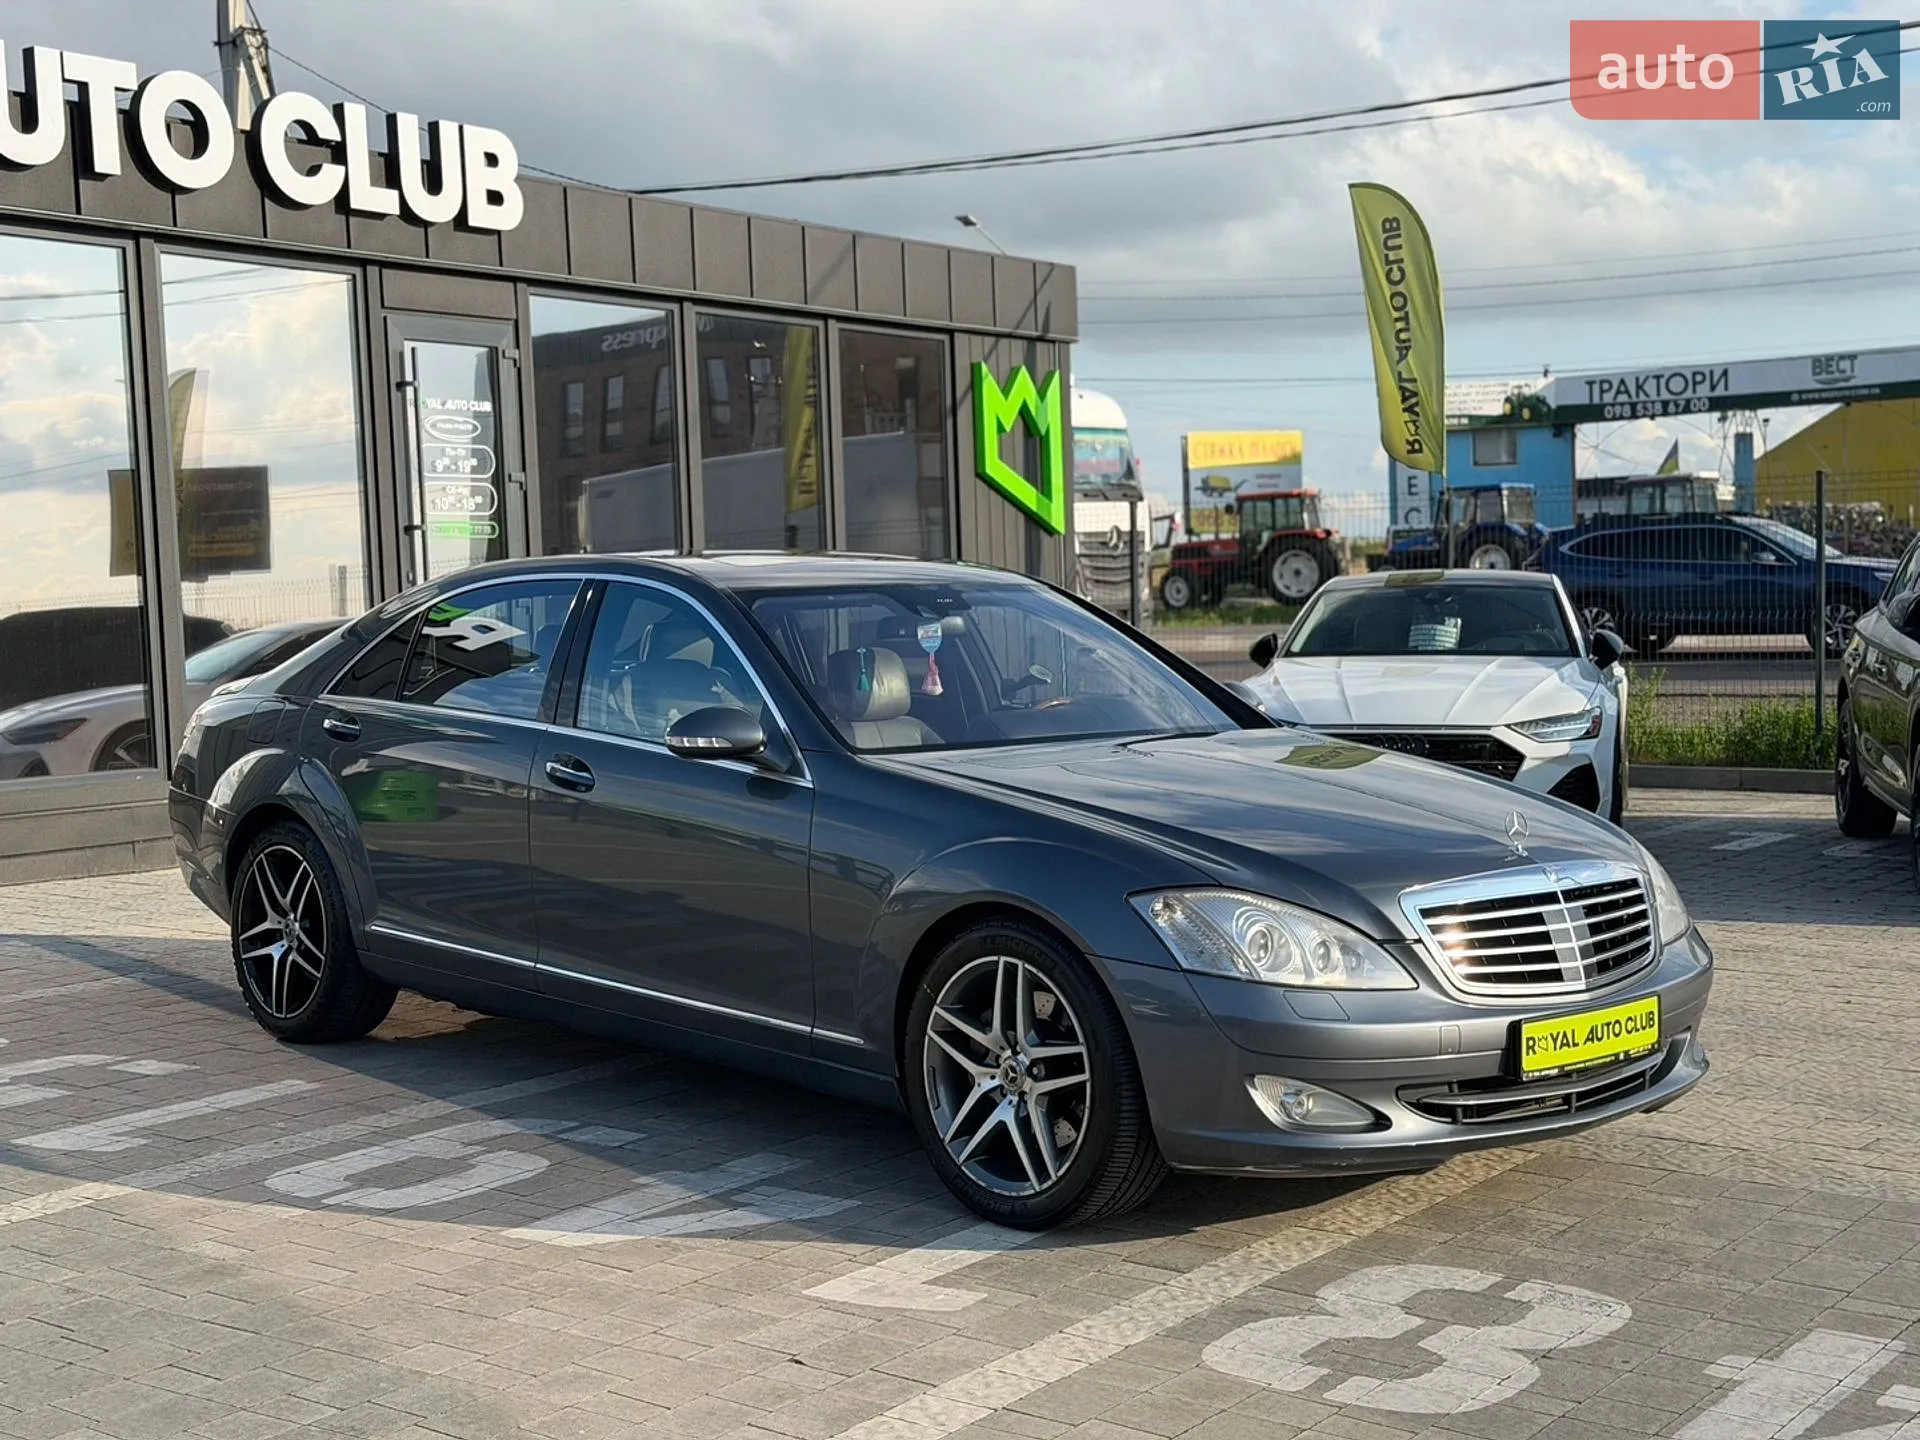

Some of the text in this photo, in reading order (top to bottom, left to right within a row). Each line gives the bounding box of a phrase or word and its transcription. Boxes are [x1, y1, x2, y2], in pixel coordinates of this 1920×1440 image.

[260, 92, 524, 231] CLUB
[1812, 353, 1859, 376] ВЕСТ
[1584, 366, 1730, 405] ТРАКТОРИ
[445, 399, 468, 411] AUTO
[469, 400, 493, 412] CLUB
[1603, 397, 1710, 420] 098 538 67 00
[1582, 1018, 1623, 1046] AUTO
[1624, 1010, 1656, 1036] CLUB
